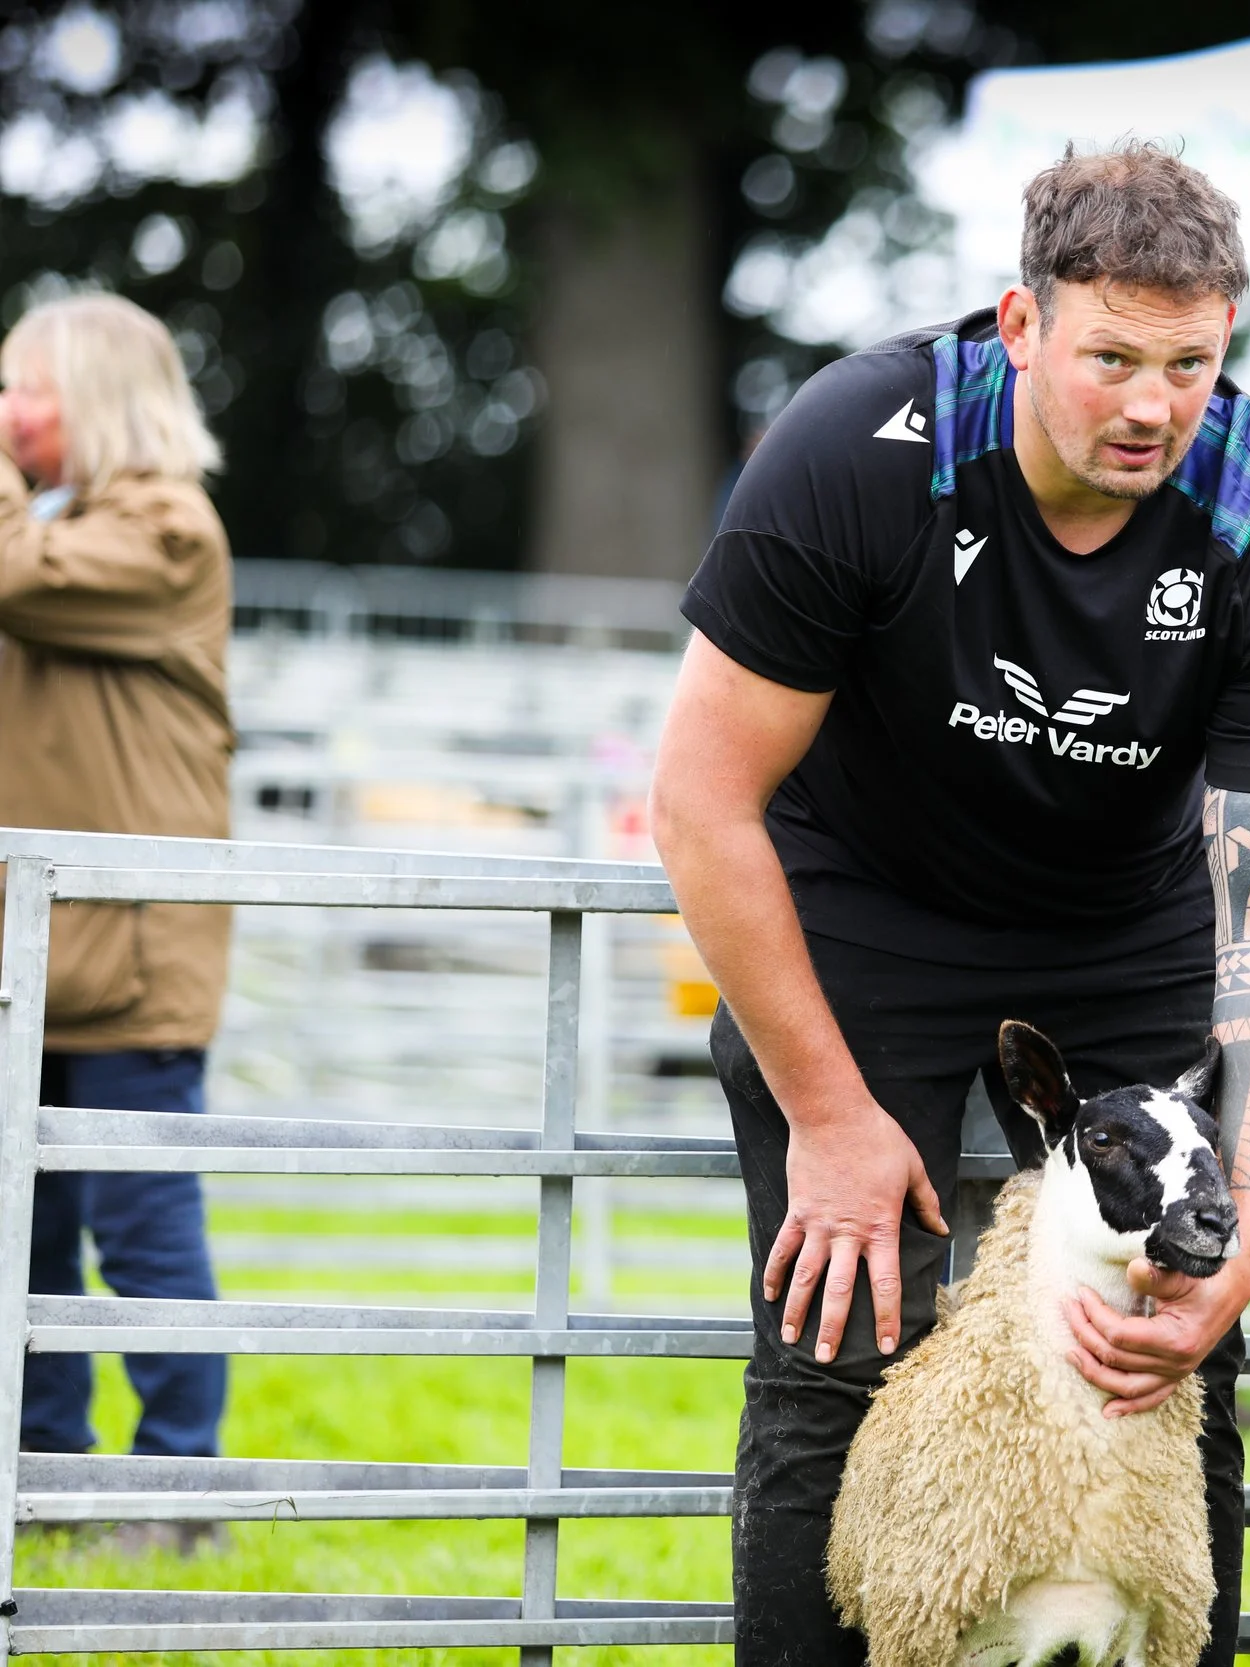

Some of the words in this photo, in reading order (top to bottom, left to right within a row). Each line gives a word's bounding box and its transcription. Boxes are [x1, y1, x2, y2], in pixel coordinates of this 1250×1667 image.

[1144, 627, 1206, 641] SCOTLAND
[948, 702, 1041, 745] Peter
[1047, 726, 1162, 770] Vardy
